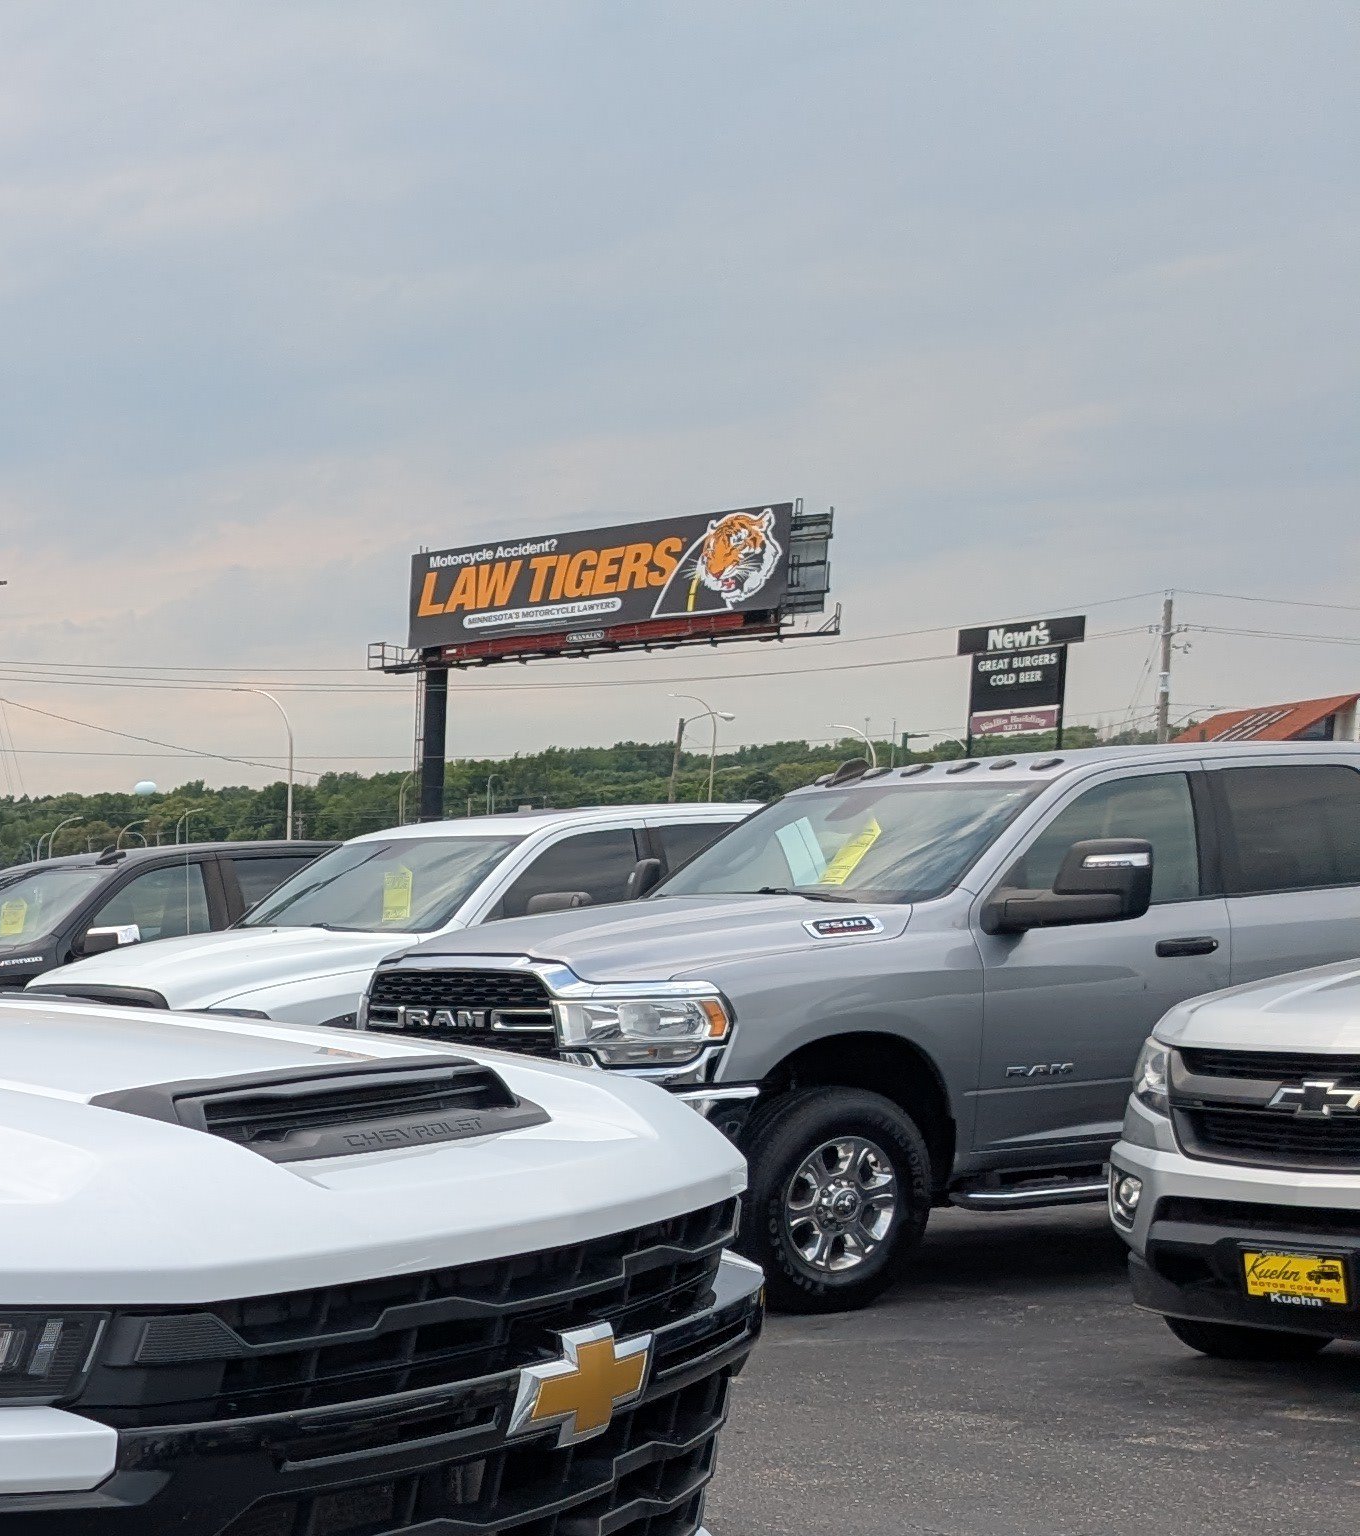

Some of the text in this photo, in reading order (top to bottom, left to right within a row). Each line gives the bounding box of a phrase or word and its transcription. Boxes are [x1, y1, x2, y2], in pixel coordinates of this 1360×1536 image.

[429, 539, 559, 569] Motorcycle Accident?
[417, 537, 684, 617] LAW TIGERS
[467, 600, 617, 625] MINNESOTA'S MOTORCYCLE LAWYERS
[987, 621, 1051, 651] Newt's
[978, 653, 1058, 672] GREAT BURGERS
[989, 670, 1042, 687] COLD BEER
[818, 919, 868, 930] 2500
[405, 1008, 486, 1028] RAM
[345, 1116, 484, 1149] CHEVROLET
[1246, 1257, 1301, 1282] Kuehn
[1250, 1280, 1286, 1289] MOTOR
[1290, 1285, 1340, 1294] COMPANY
[1270, 1292, 1323, 1306] Kuehn
